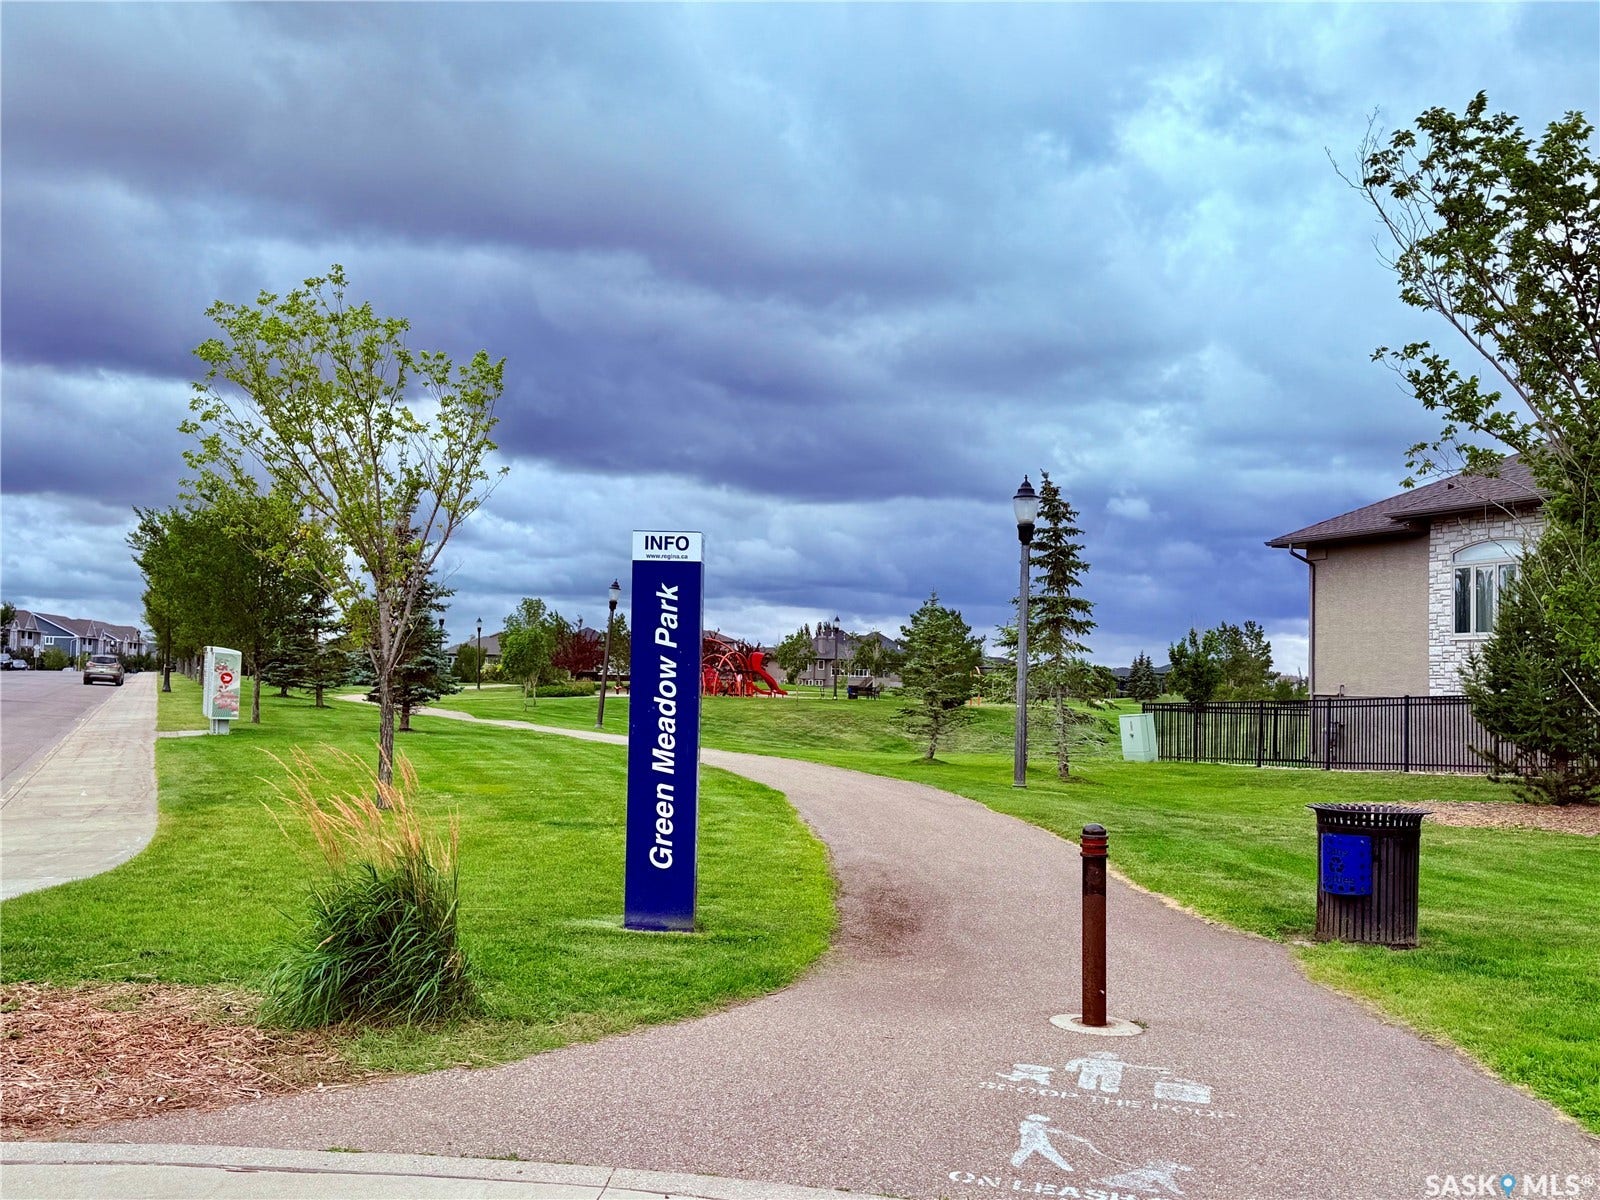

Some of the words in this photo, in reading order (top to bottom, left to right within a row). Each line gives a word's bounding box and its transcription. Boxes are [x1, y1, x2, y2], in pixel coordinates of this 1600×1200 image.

[645, 535, 690, 551] INFO
[654, 582, 679, 649] Park
[651, 655, 678, 775] Meadow
[648, 782, 675, 870] Green
[948, 1170, 1002, 1188] ON
